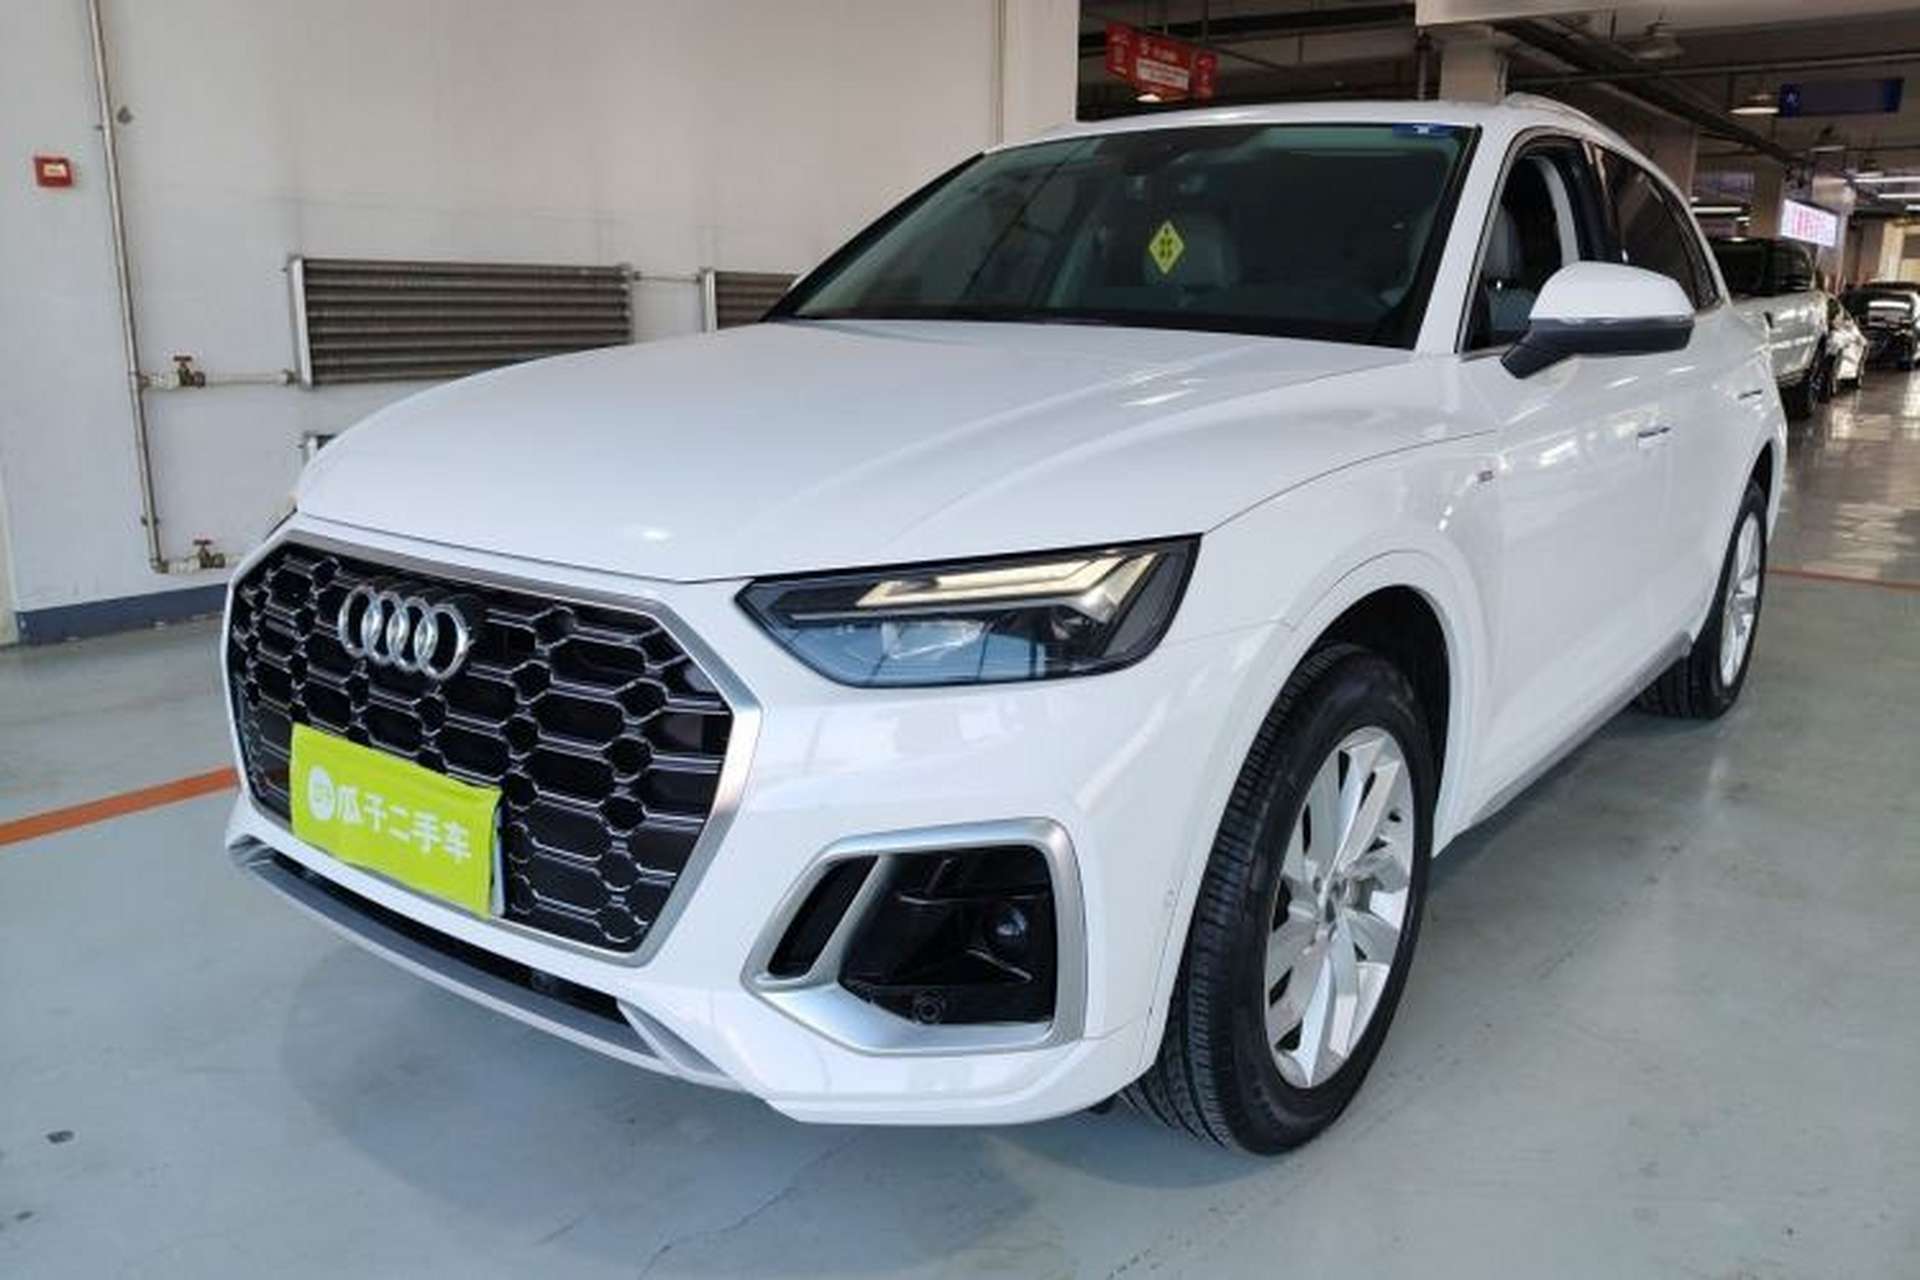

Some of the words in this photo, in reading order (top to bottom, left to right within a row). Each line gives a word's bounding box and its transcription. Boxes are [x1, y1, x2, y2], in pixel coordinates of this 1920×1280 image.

[337, 785, 471, 863] 瓜子二手车
